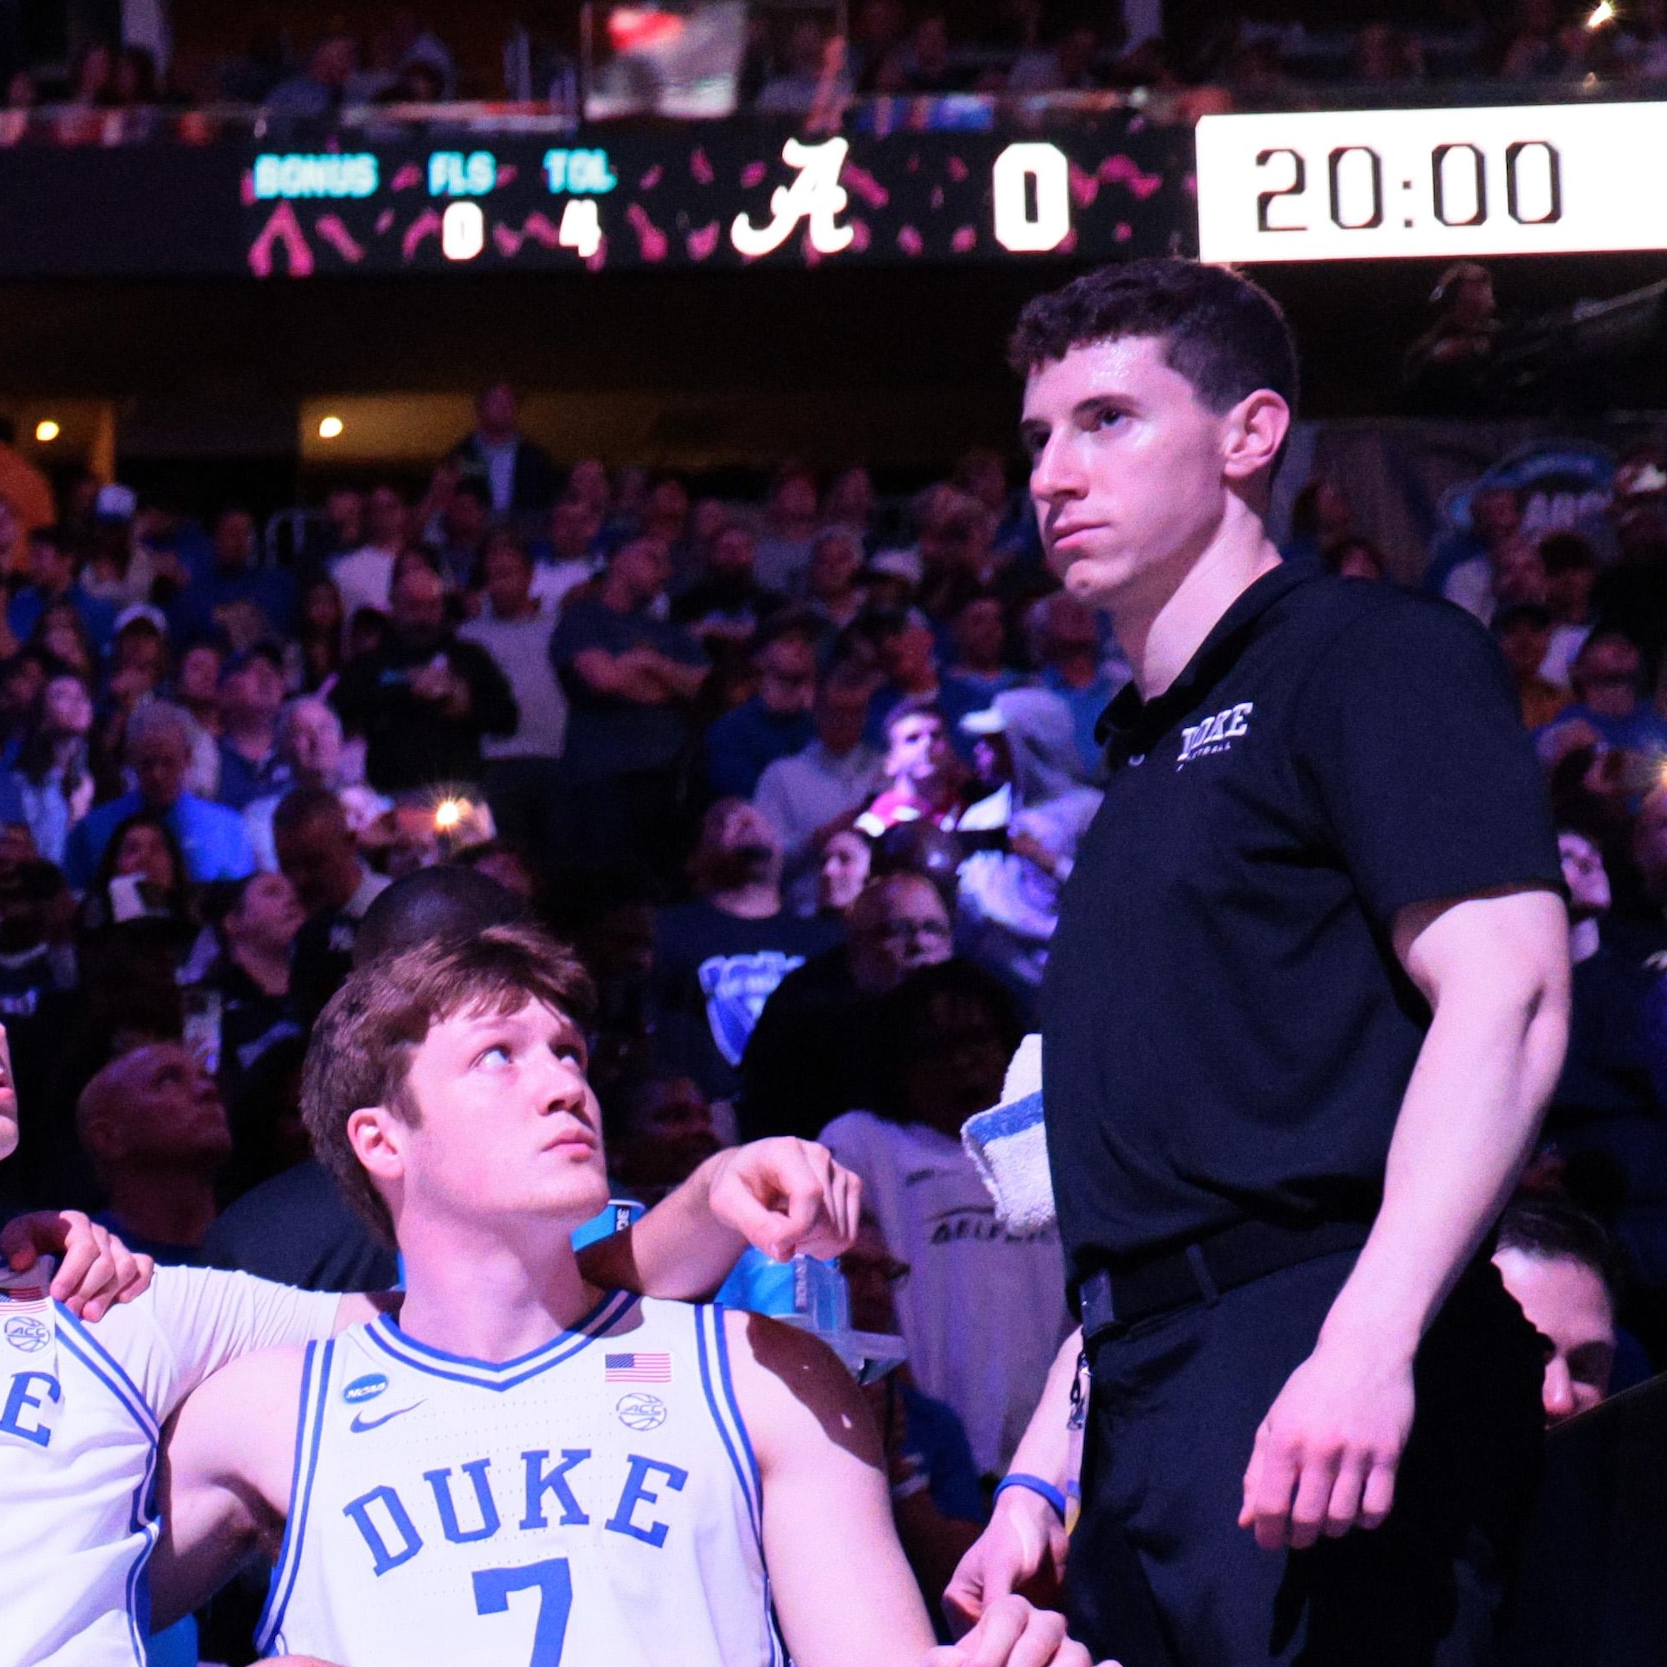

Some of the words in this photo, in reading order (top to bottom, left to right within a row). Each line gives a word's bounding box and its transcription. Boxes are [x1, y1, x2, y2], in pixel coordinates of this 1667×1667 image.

[254, 152, 378, 199] BONUS
[428, 151, 496, 196] FLS
[543, 148, 618, 194] TOL
[992, 143, 1070, 251] 0
[1255, 139, 1564, 232] 20:00
[442, 202, 484, 260] 0
[558, 199, 602, 257] 4
[10, 1326, 47, 1338] ACC
[620, 1403, 663, 1416] ACC
[342, 1448, 689, 1578] DUKE
